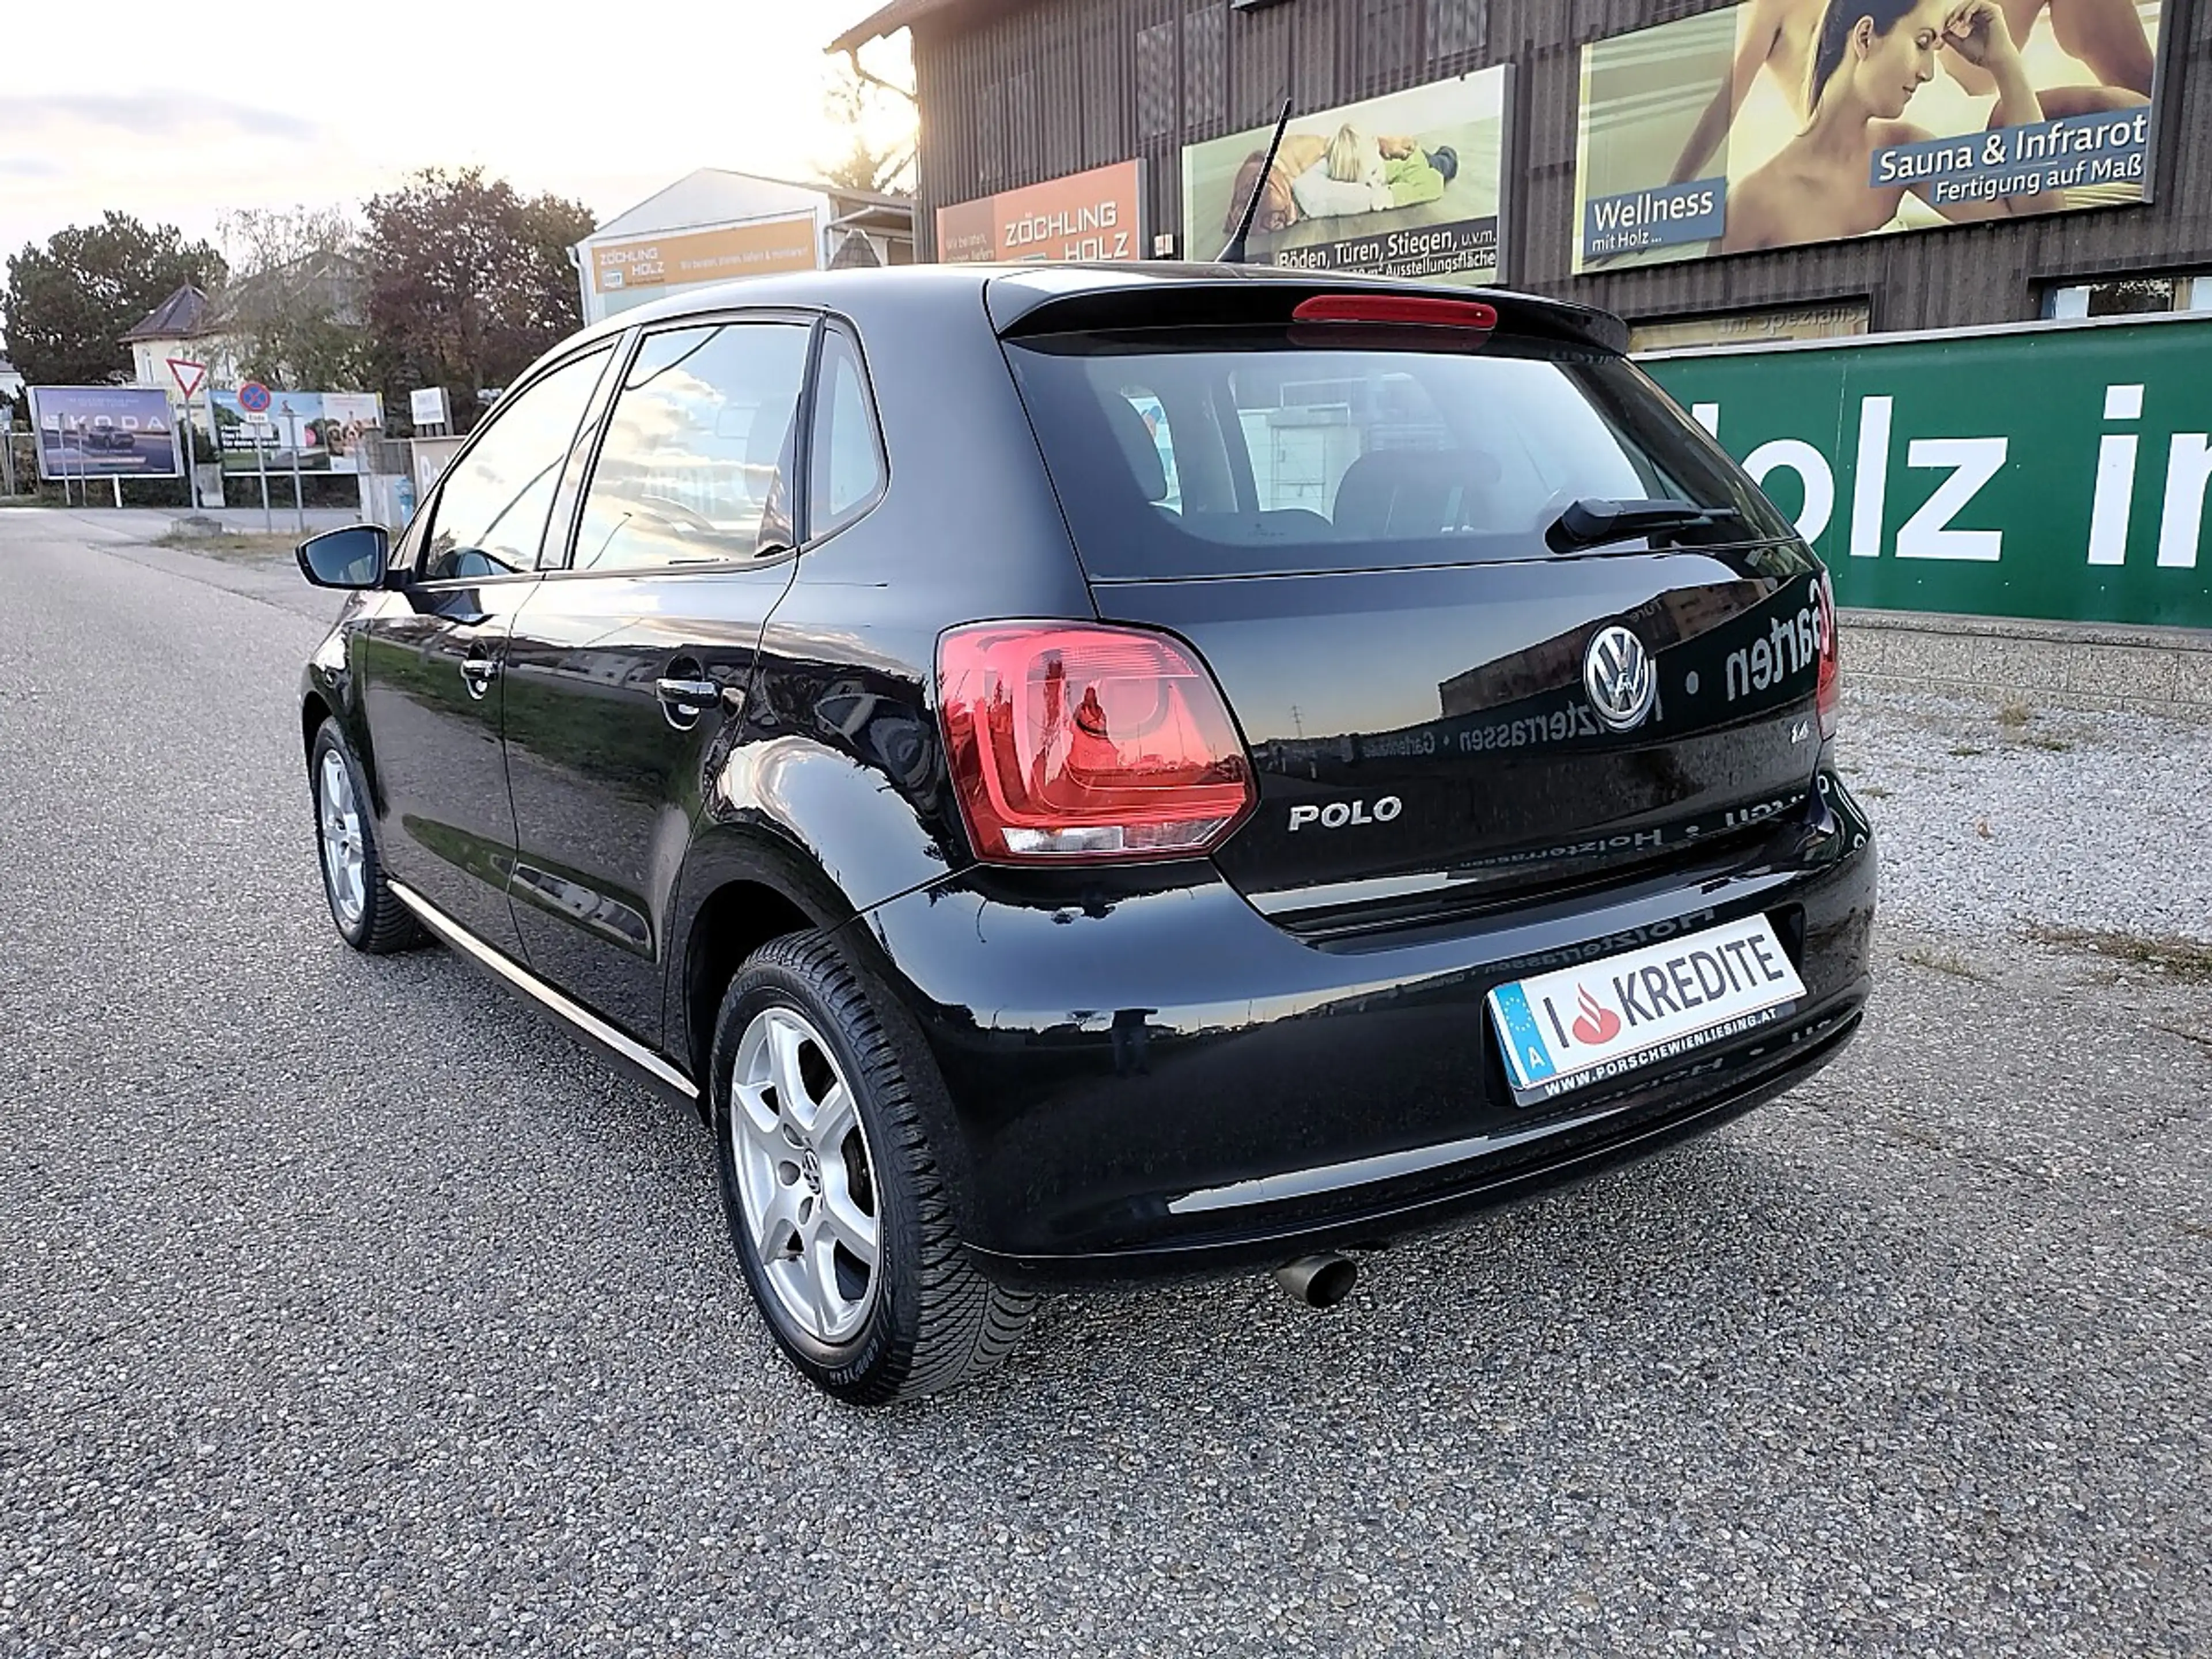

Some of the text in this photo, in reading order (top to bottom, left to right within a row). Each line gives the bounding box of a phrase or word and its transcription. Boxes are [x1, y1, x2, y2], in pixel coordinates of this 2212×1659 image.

[1878, 113, 2147, 182] Sauna & Infrarot
[1935, 153, 2143, 203] Fertigung auf Maß
[1004, 200, 1118, 248] ZÖCHLING
[1594, 191, 1714, 232] Wellness
[1065, 232, 1129, 261] HOLZ
[1279, 248, 1330, 270] Böden,
[1334, 242, 1384, 266] Türen,
[1387, 231, 1457, 258] Stiegen,
[1592, 233, 1618, 252] mit
[631, 261, 665, 276] HOLZ
[1385, 249, 1497, 277] Ausstellungsfläche
[1691, 395, 2010, 562] olz
[1287, 796, 1403, 832] POLO
[1612, 933, 1785, 1027] KREDITE
[1528, 1047, 1546, 1070] A
[1544, 1006, 1778, 1098] WWW.PORSCHEWIENLIESING.AT
